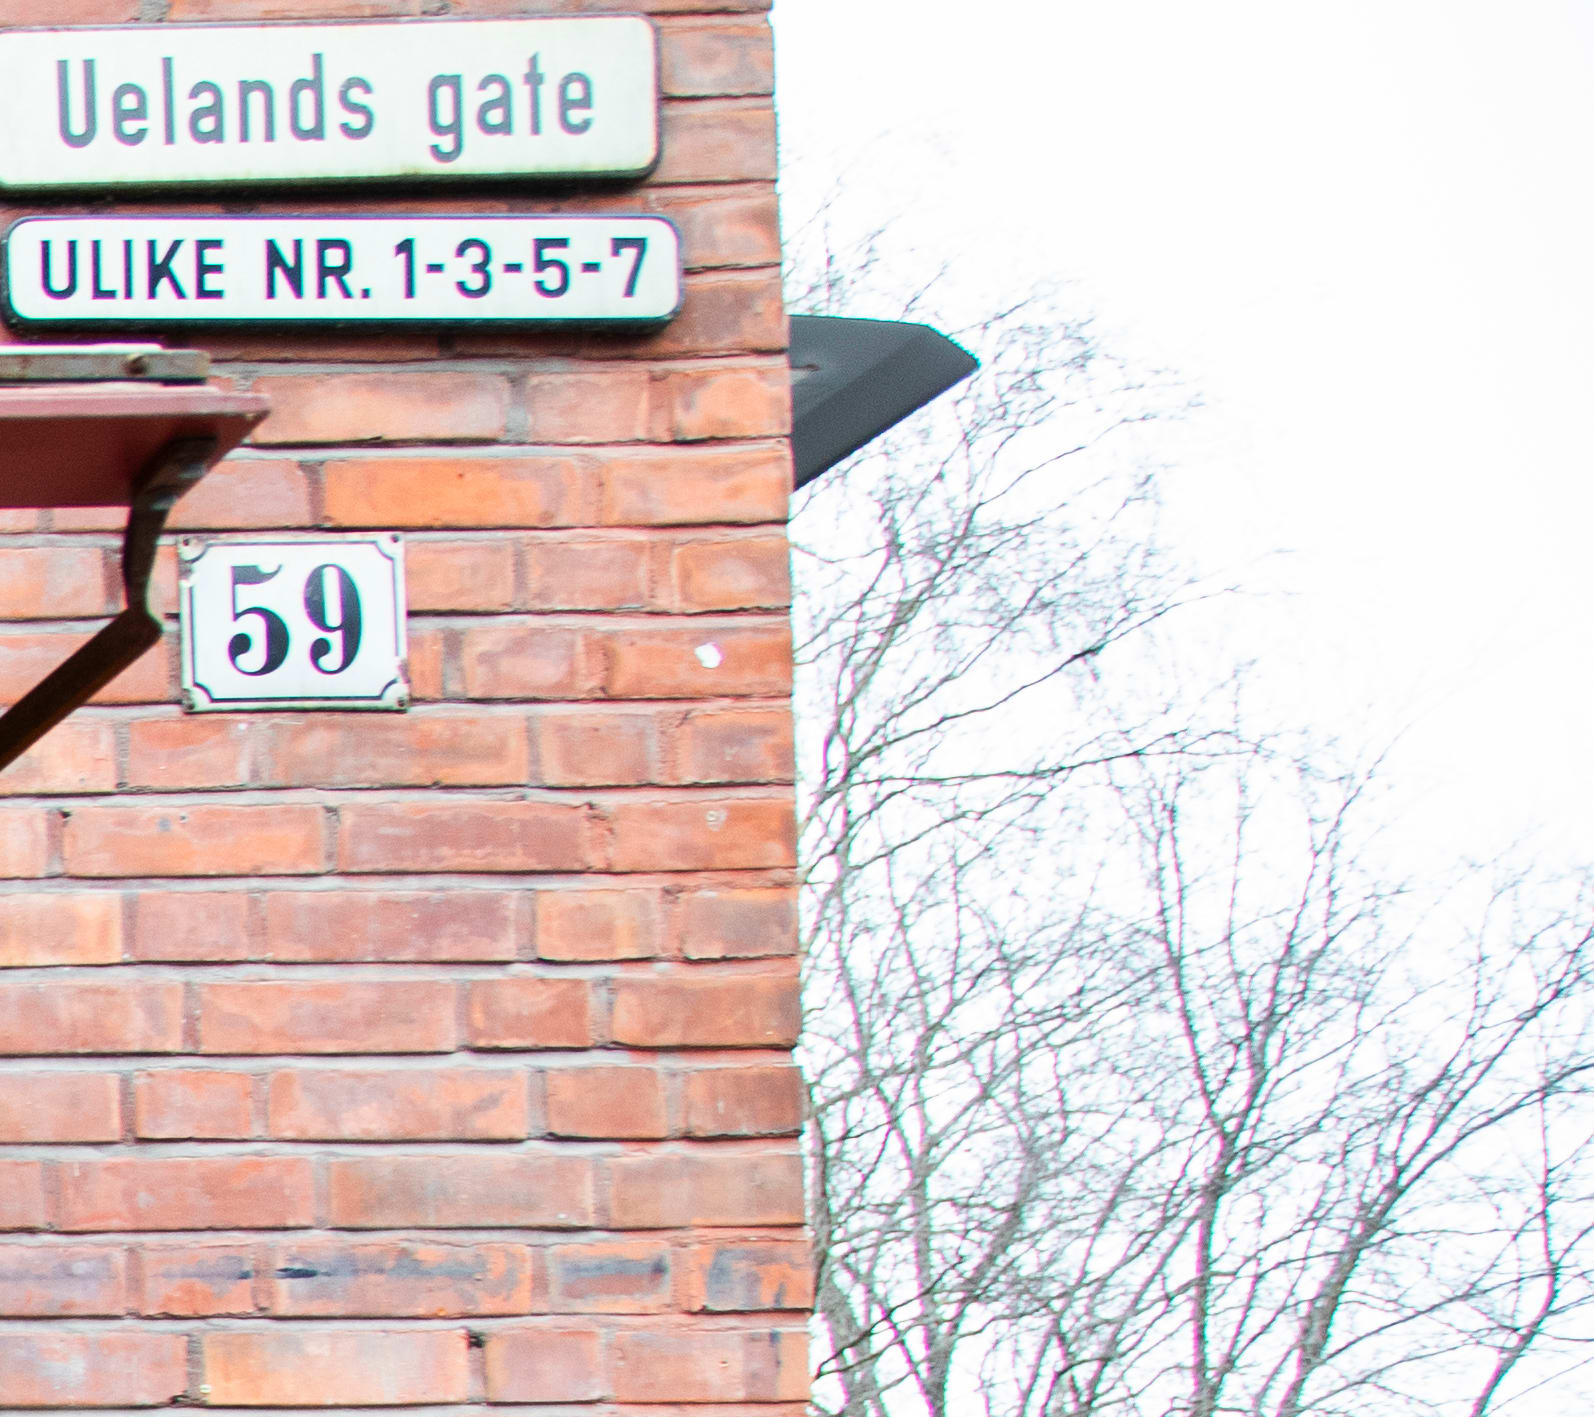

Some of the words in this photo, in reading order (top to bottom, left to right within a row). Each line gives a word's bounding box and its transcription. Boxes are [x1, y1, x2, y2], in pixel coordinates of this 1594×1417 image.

[57, 52, 374, 148] Uelands
[427, 53, 593, 162] gate
[41, 239, 224, 300] ULIKE
[266, 238, 370, 300] NR.
[394, 237, 648, 299] 1-3-5-7
[227, 563, 363, 677] 59
